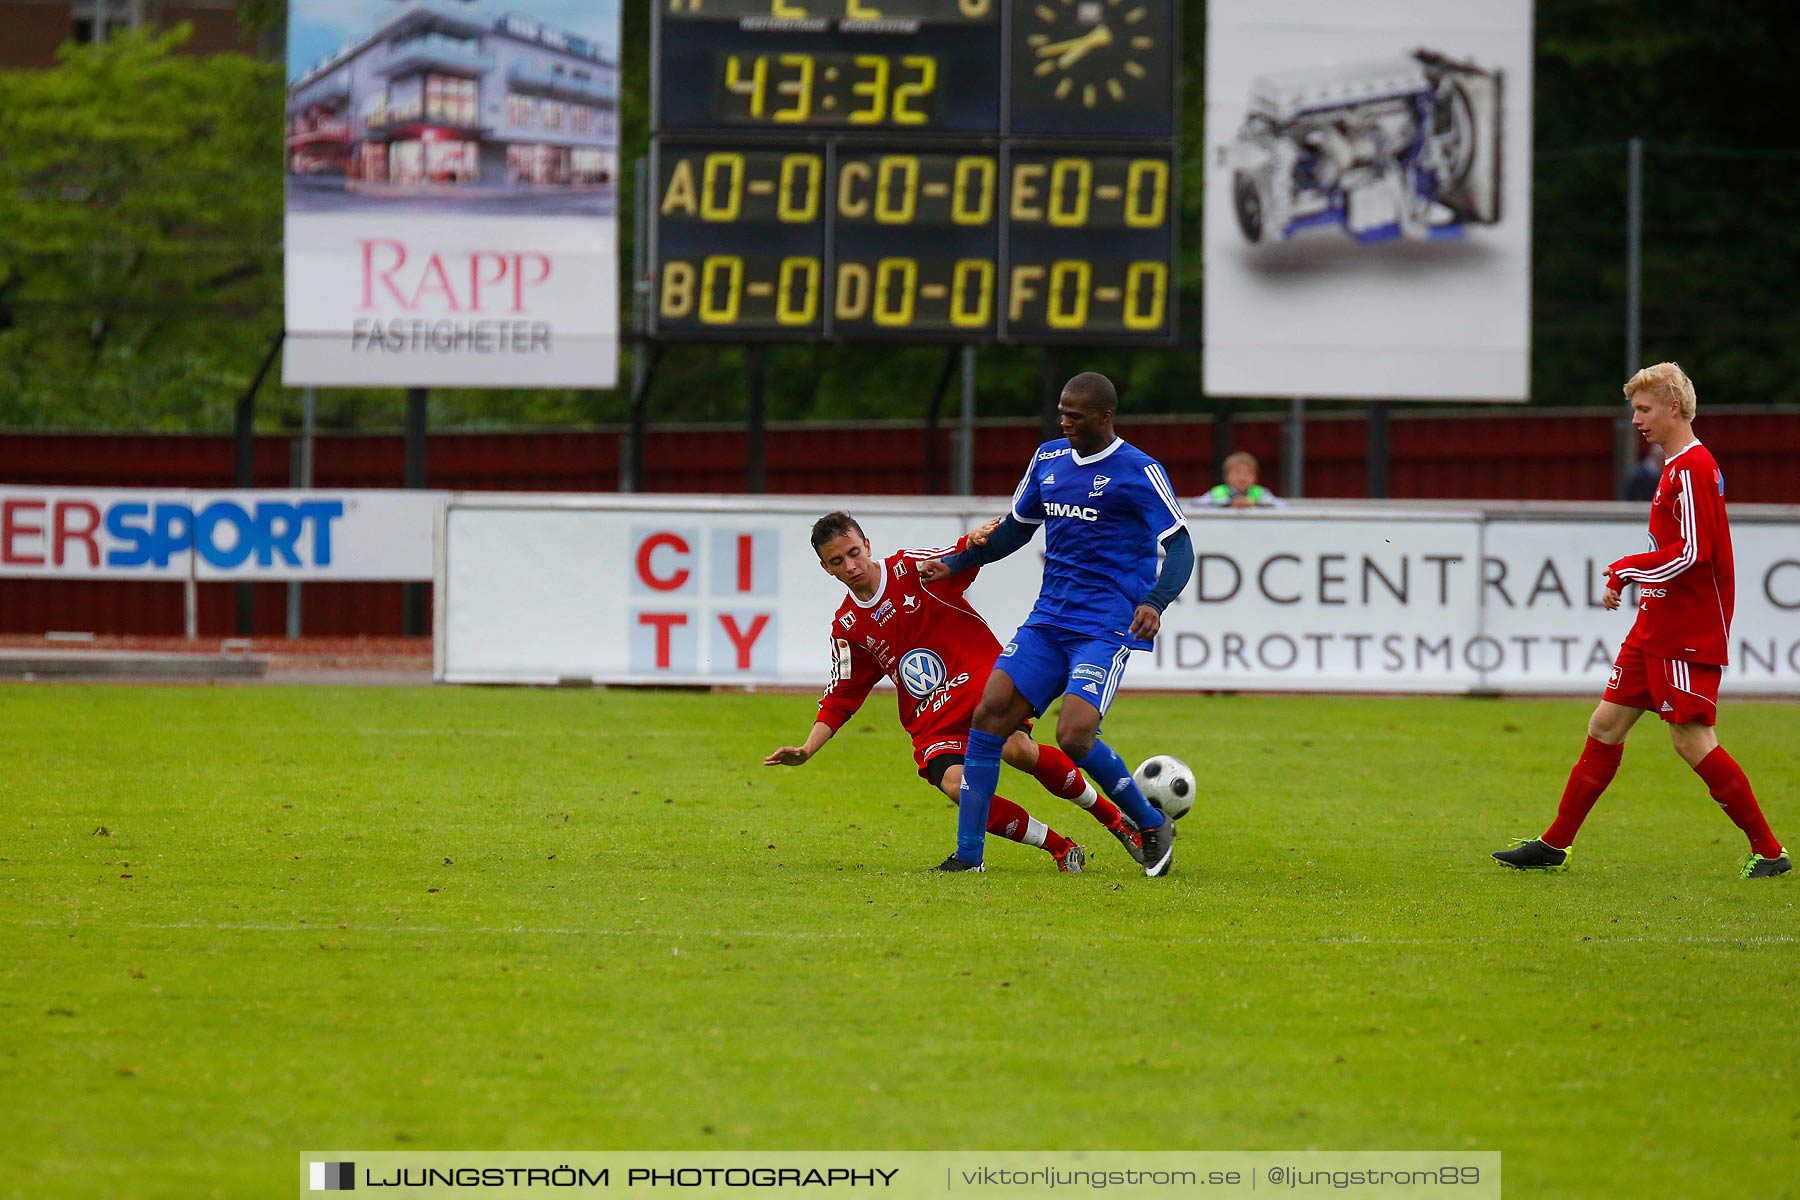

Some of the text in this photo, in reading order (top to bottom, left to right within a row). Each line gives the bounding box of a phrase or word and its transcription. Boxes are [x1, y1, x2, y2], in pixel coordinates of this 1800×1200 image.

[725, 53, 937, 125] 43:32
[355, 238, 552, 313] RAPP
[352, 320, 551, 352] FASTIGHETER
[932, 692, 952, 713] BIL
